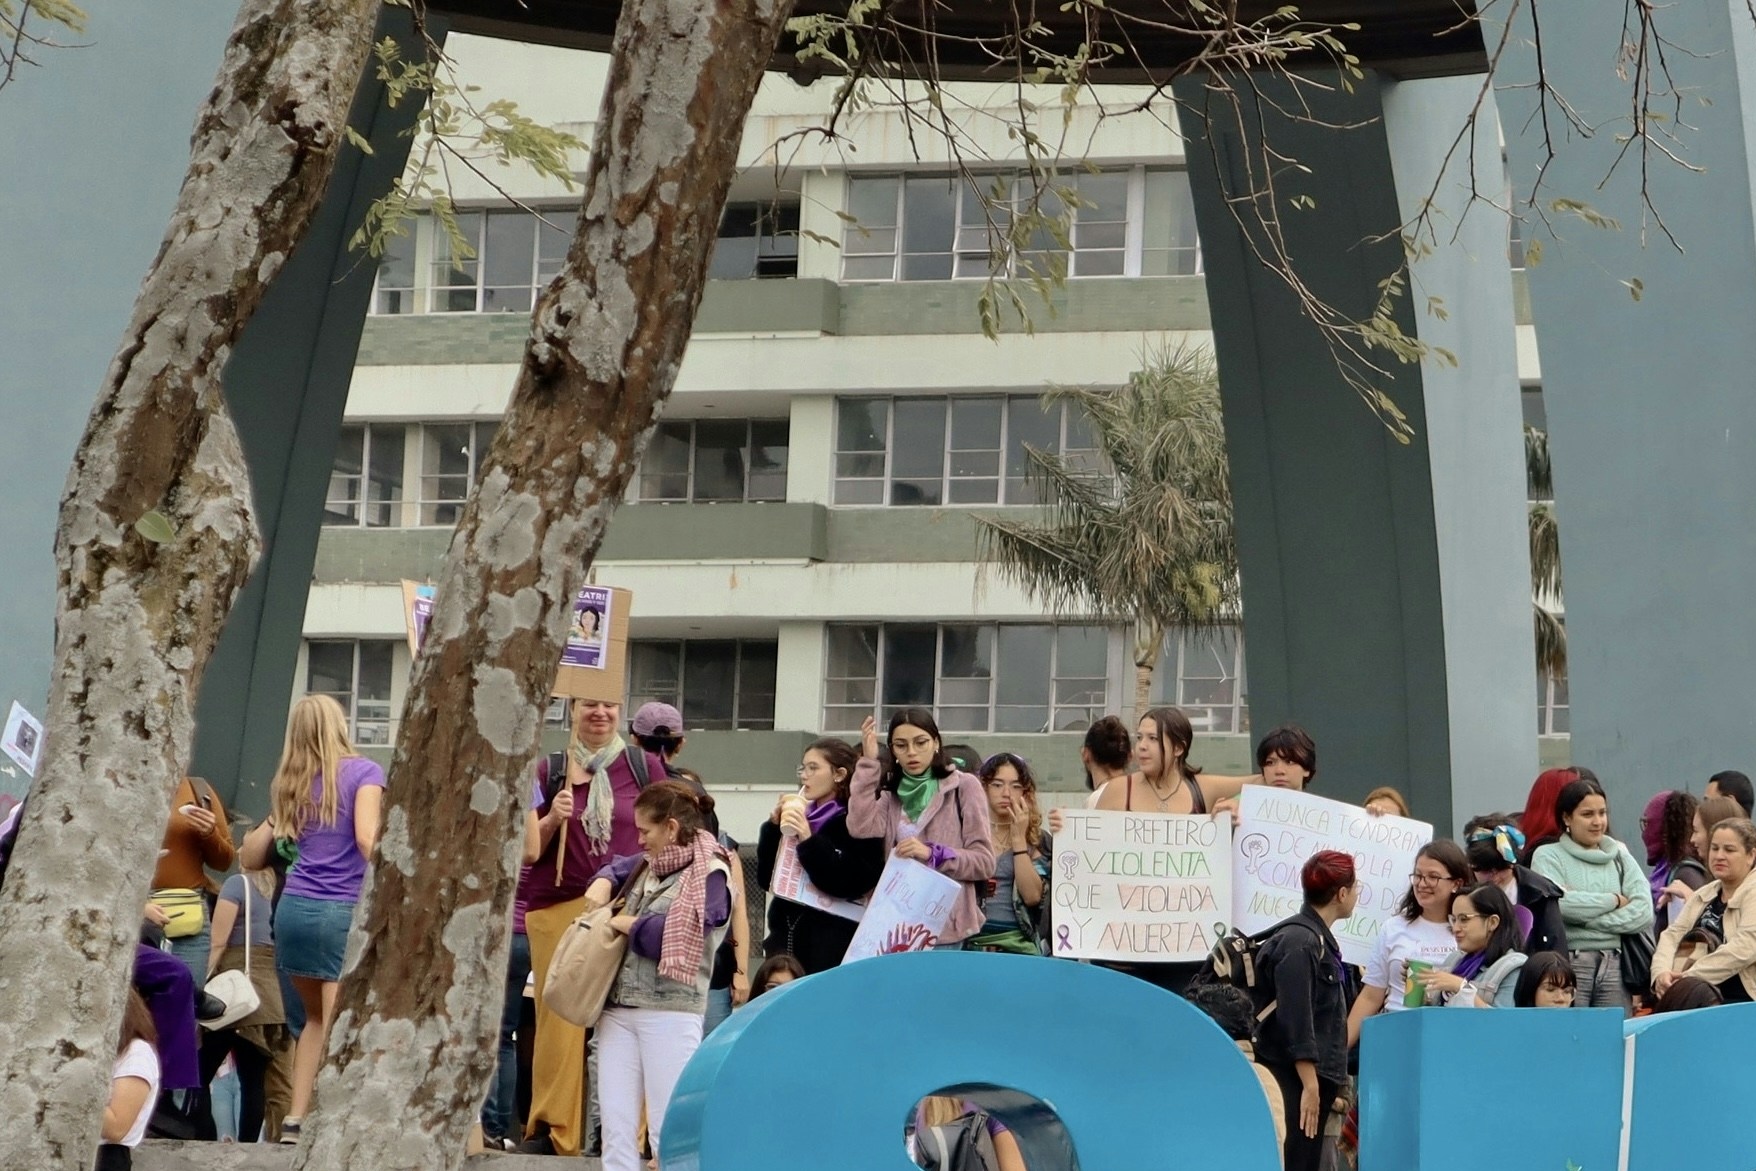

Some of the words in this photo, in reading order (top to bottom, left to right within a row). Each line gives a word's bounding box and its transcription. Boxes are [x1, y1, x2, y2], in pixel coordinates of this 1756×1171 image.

[1066, 816, 1102, 841] TE
[1124, 817, 1218, 847] PREFIERO
[1256, 798, 1330, 833] NUNCA
[1082, 851, 1211, 878] VIOLENTA
[1278, 831, 1306, 859] DE
[1369, 857, 1393, 879] LA
[1055, 882, 1101, 913] QUE
[1117, 883, 1219, 914] VIOLADA
[1247, 891, 1302, 920] NUES
[1072, 916, 1093, 949] Y
[1097, 921, 1210, 954] MUERTA
